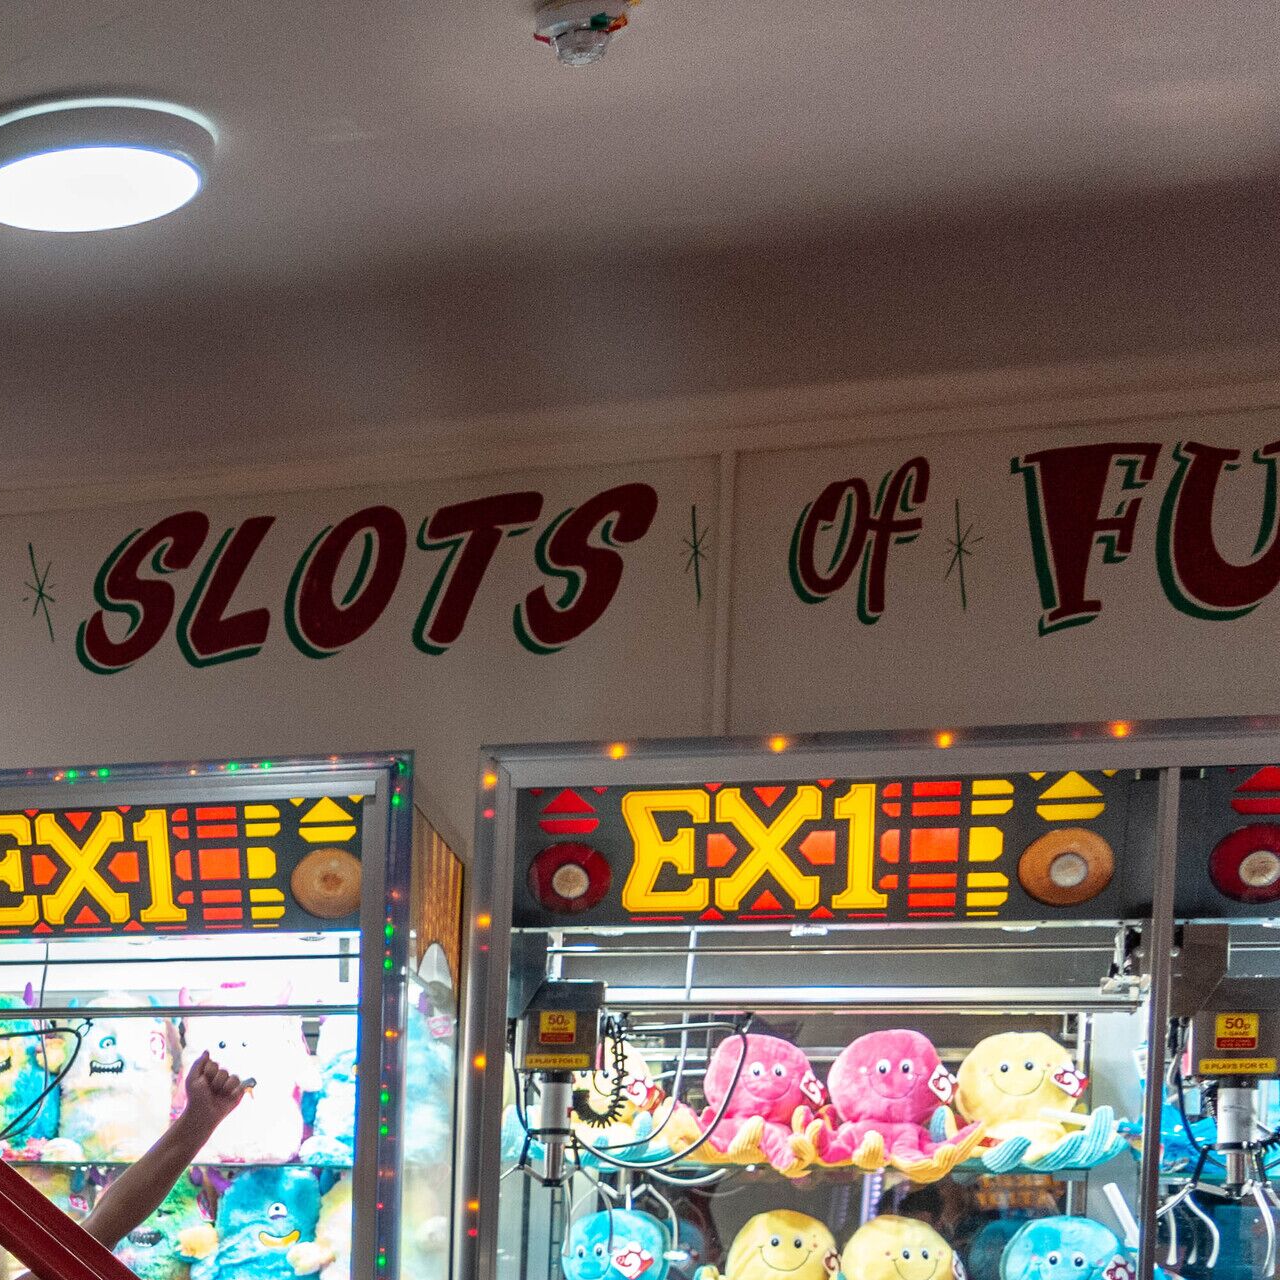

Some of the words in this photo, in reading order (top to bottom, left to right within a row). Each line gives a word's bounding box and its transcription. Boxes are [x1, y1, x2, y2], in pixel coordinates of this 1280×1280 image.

[76, 482, 659, 674] SLOTS
[621, 783, 889, 913] EX1
[1225, 1018, 1251, 1031] 50p
